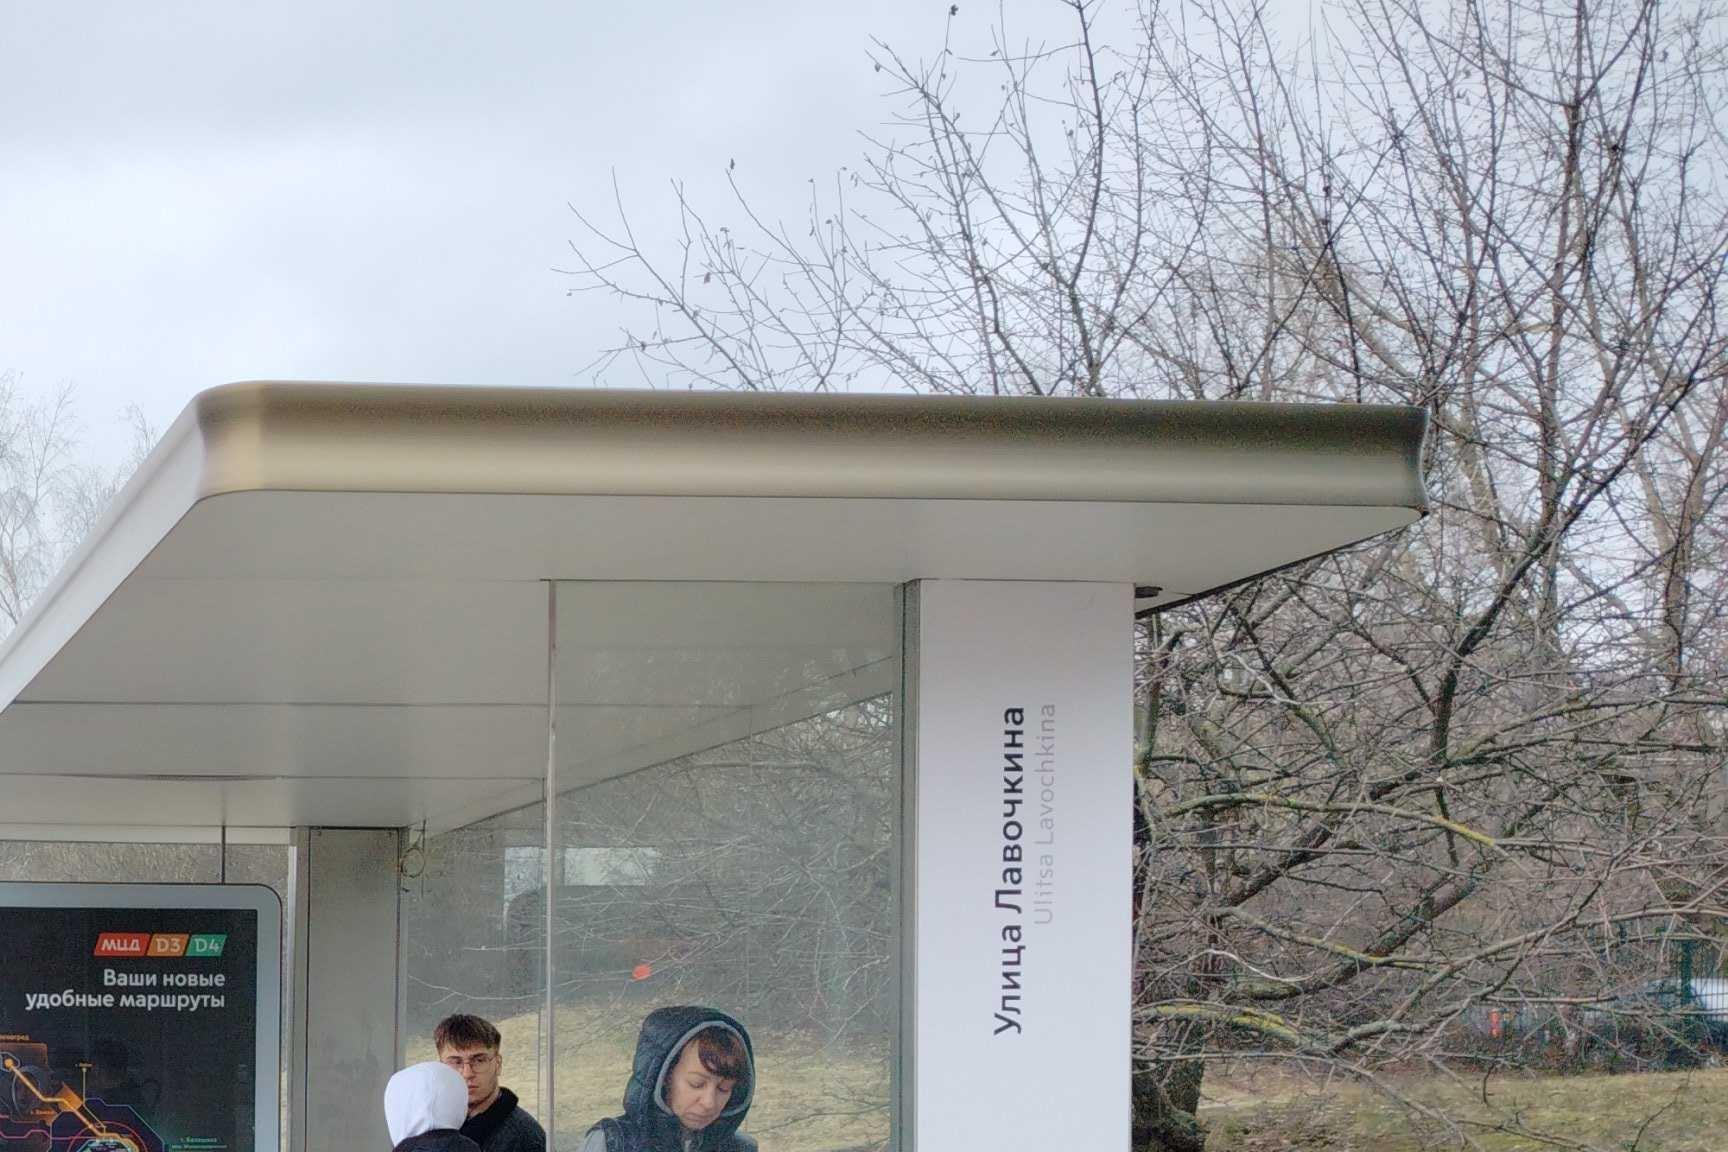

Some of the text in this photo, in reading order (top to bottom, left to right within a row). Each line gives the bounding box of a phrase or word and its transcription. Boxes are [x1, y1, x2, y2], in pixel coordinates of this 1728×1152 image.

[1033, 703, 1057, 926] Ulitsa Lavochkina
[993, 706, 1026, 1036] Улица Лавочкина
[100, 938, 221, 953] МЦД D3 D4
[103, 968, 226, 987] Ваши новые
[25, 989, 225, 1012] удобные маршруты
